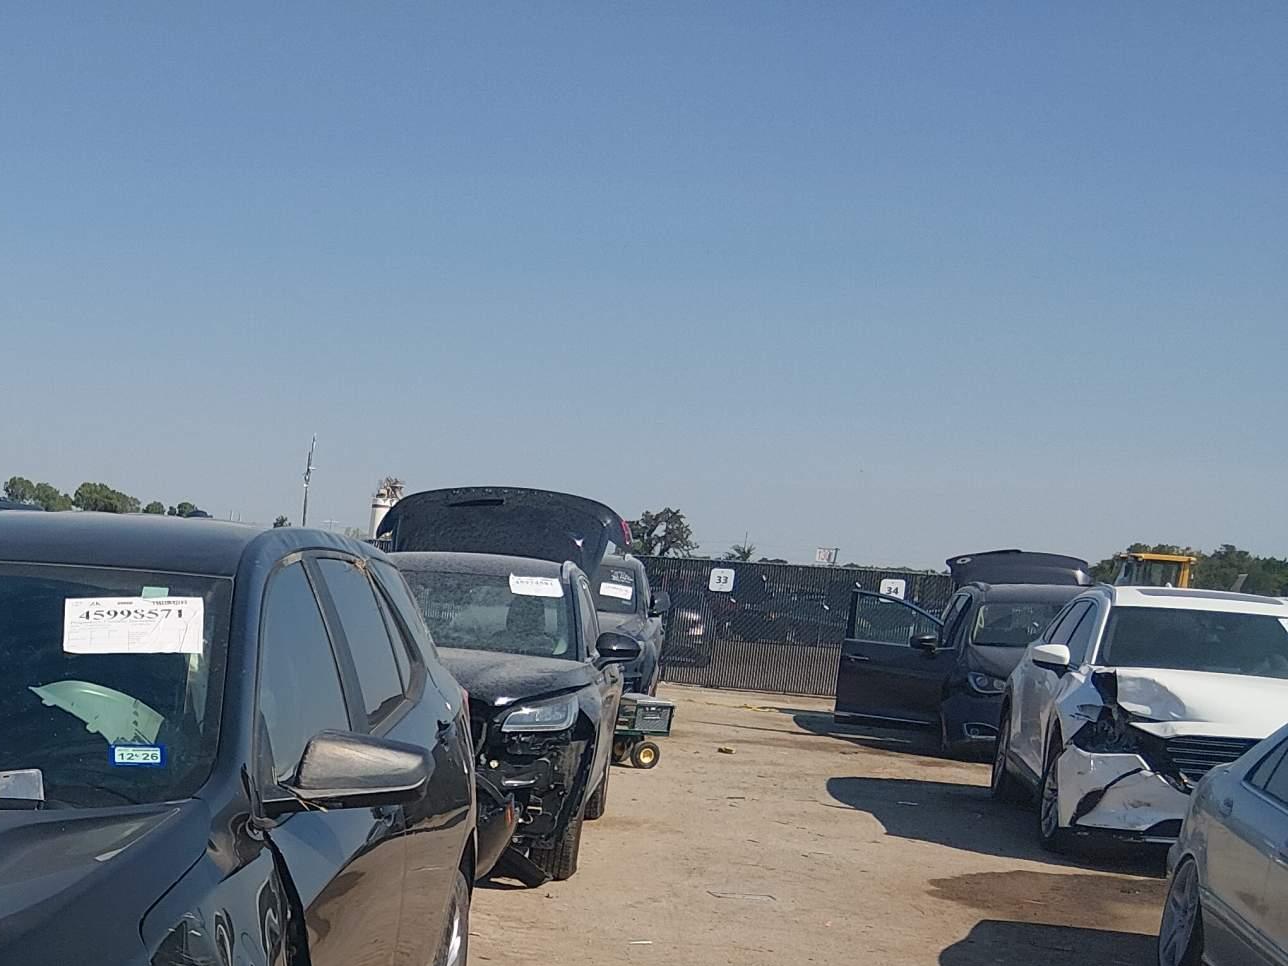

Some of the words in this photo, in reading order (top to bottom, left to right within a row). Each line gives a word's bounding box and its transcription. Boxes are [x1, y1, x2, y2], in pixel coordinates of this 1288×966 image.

[715, 575, 729, 584] 33
[886, 586, 899, 595] 34
[118, 752, 134, 761] 12
[141, 752, 159, 761] 26
